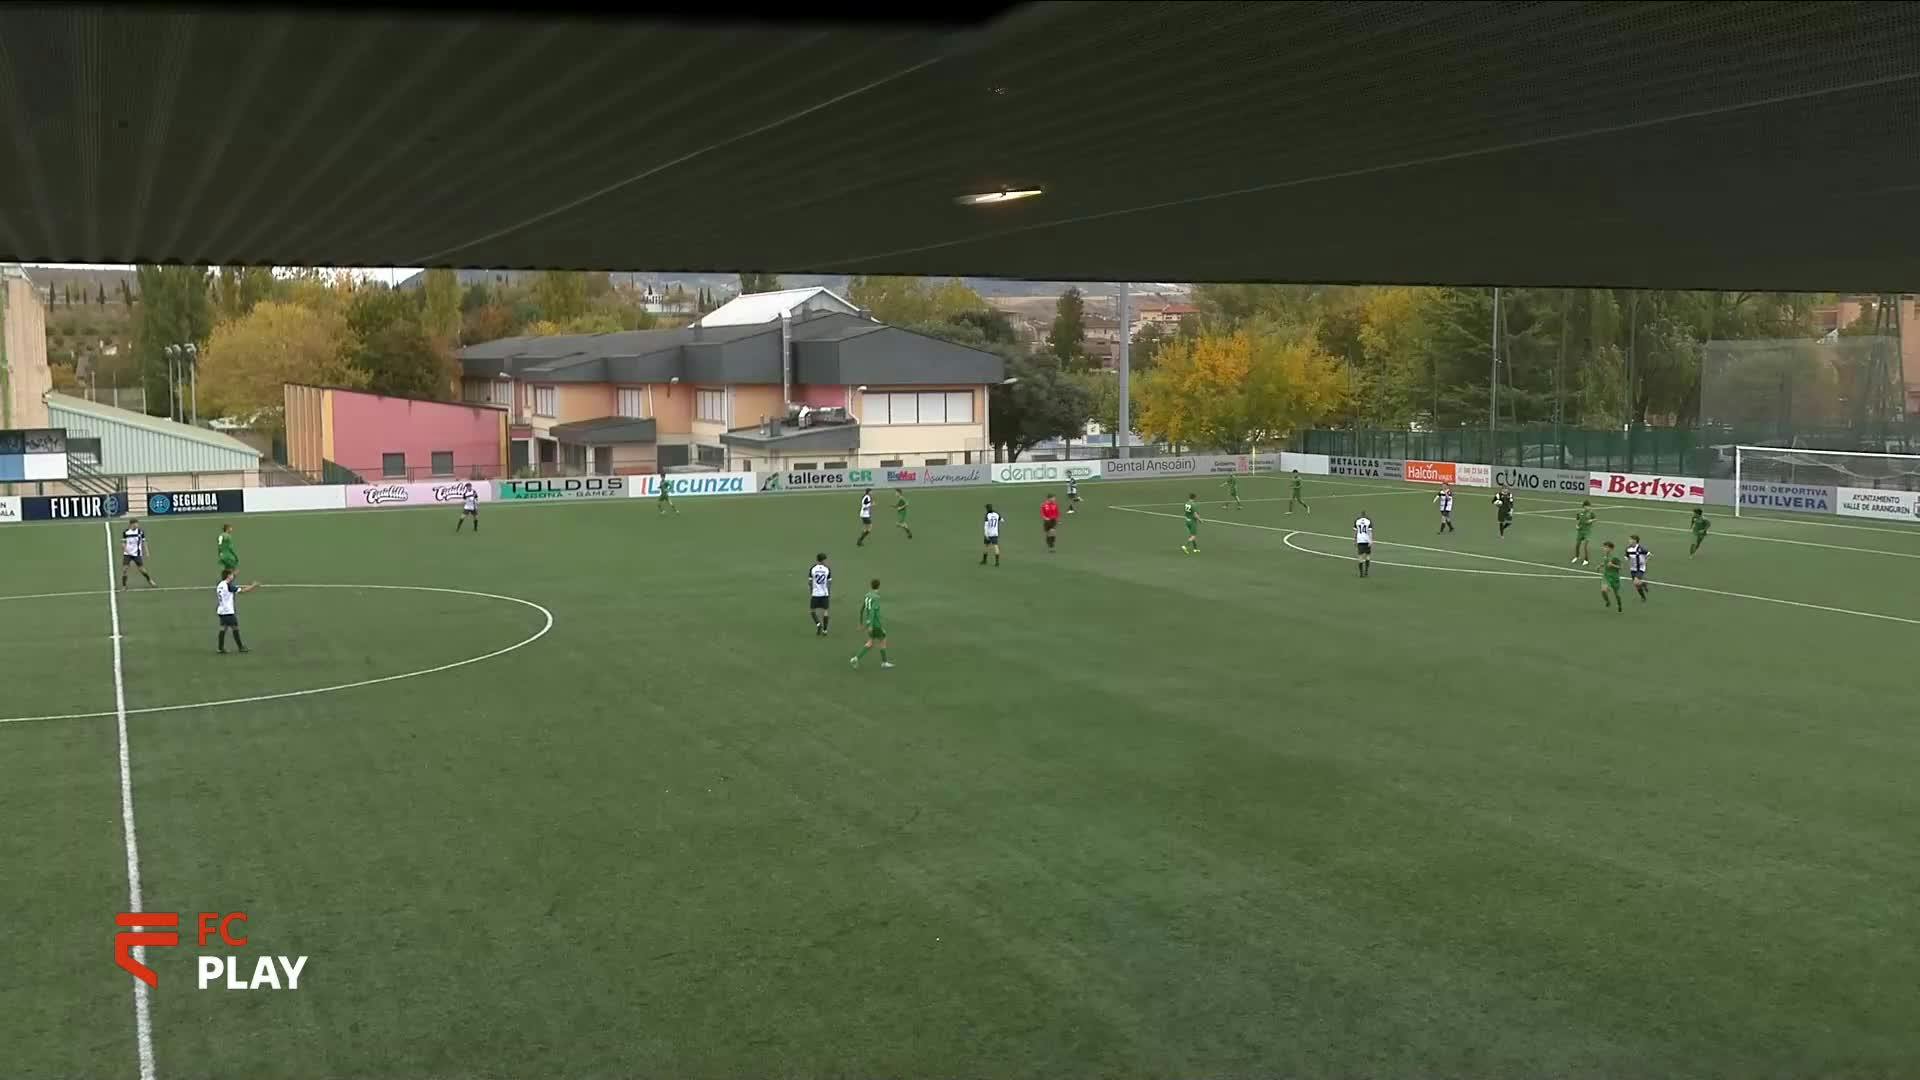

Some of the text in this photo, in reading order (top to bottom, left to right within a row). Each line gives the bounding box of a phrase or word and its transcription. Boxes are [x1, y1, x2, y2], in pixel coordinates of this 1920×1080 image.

[1001, 464, 1057, 480] denda
[1107, 460, 1144, 472] Dental
[1330, 467, 1380, 477] MUTILVA
[788, 469, 872, 484] talleres CR
[507, 478, 622, 493] TOLDOS
[1543, 480, 1556, 488] en
[1560, 480, 1585, 491] casa
[1608, 475, 1685, 498] Berlys
[173, 493, 217, 507] SEGUNDA
[1853, 494, 1900, 503] AYUNTAMIENTO
[1358, 525, 1367, 534] 14
[815, 574, 826, 585] 22
[865, 597, 872, 610] 11
